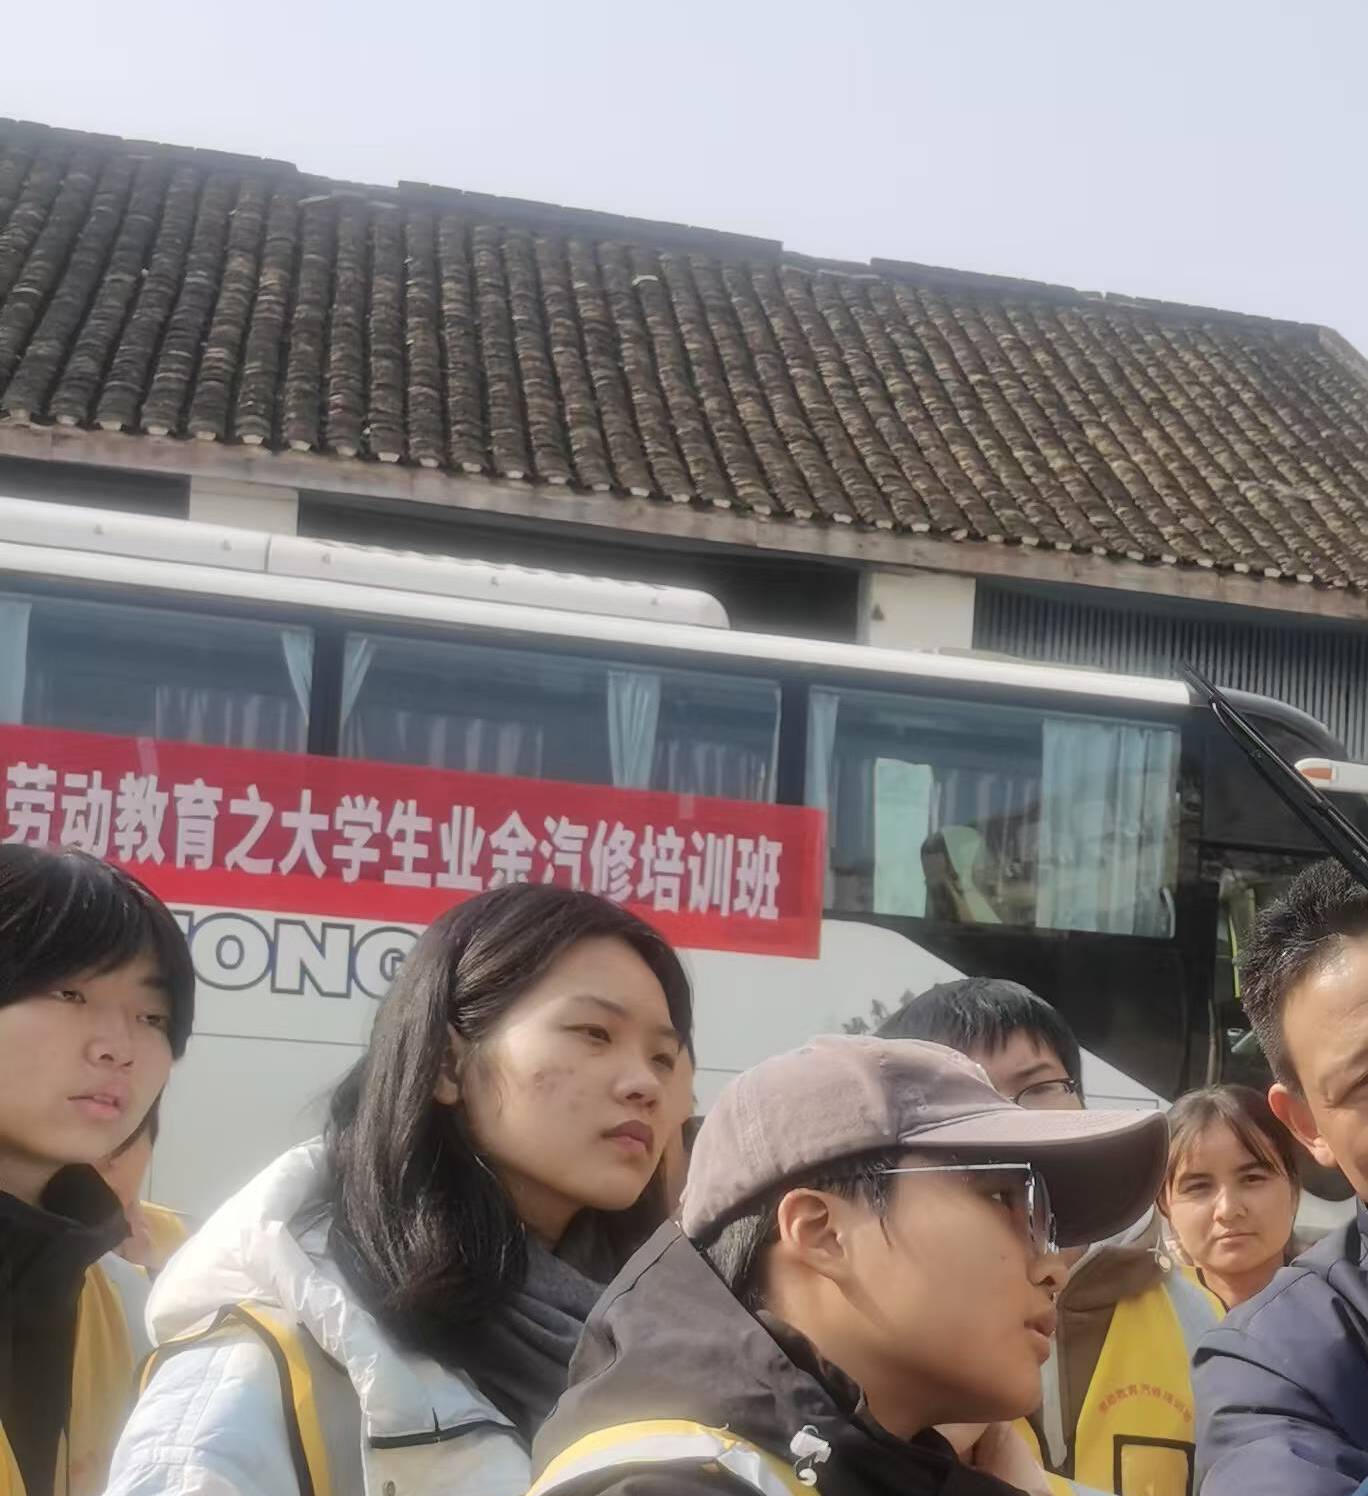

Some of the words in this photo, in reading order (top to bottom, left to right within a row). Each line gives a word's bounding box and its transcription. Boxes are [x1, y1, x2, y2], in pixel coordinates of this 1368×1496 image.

[3, 761, 783, 920] 劳动教育之大学生业余汽修培训班
